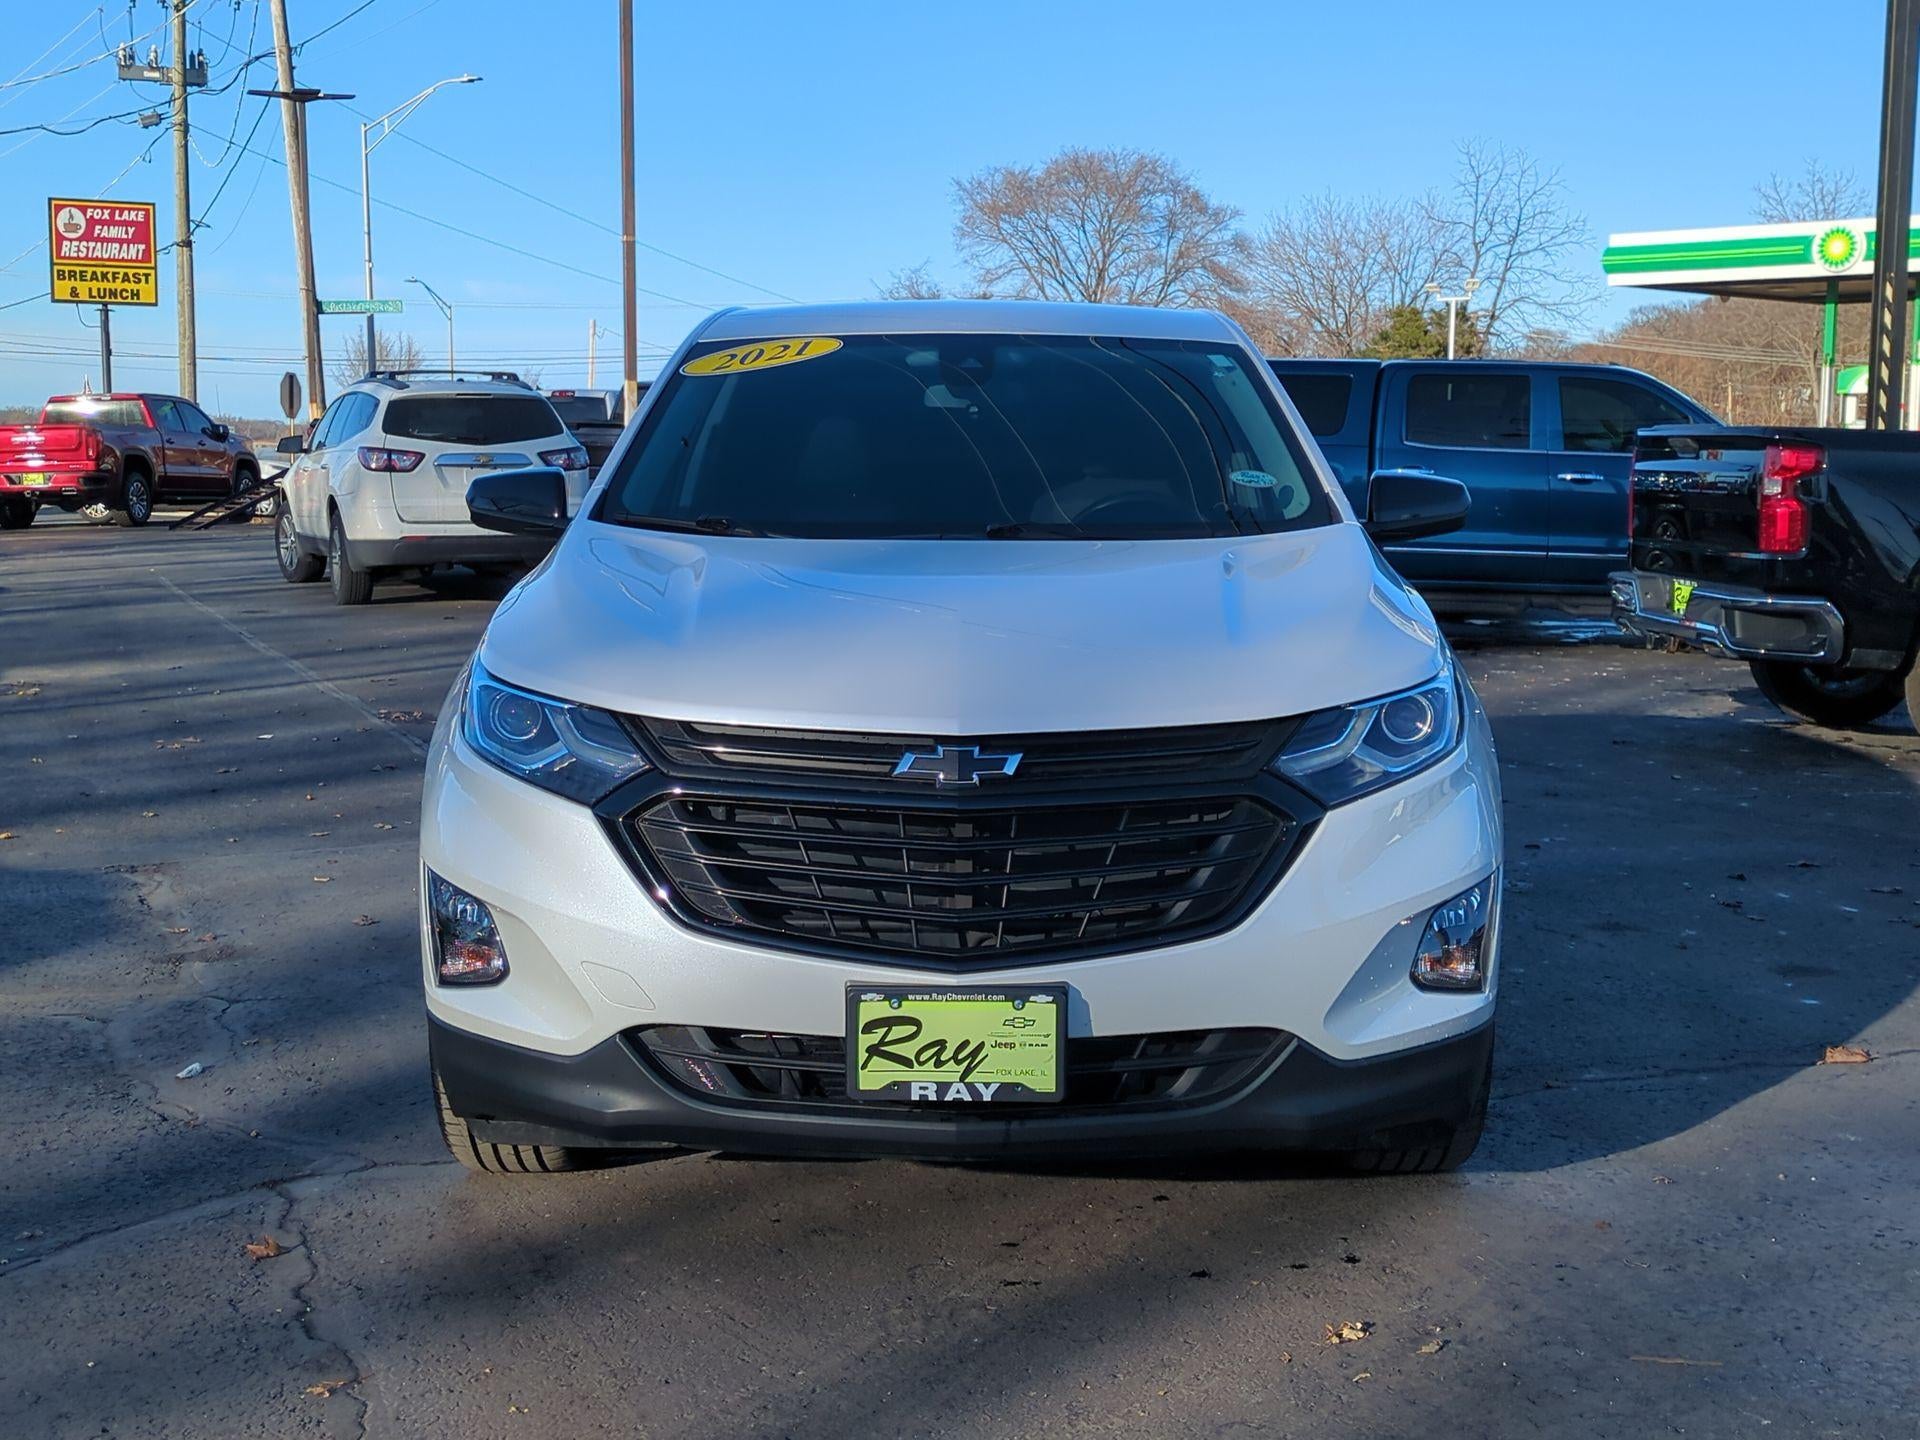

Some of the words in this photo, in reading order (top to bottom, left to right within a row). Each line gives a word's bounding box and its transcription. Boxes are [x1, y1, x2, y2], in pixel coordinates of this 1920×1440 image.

[86, 208, 111, 220] FOX
[115, 209, 145, 221] LAKE
[94, 225, 135, 239] FAMILY
[61, 240, 145, 260] RESTAURANT
[56, 269, 151, 284] BREAKFAST
[69, 286, 80, 298] &
[88, 287, 140, 300] LUNCH
[712, 340, 813, 371] 2021
[907, 993, 1005, 1002] www.RayChevrolet.com
[861, 1015, 989, 1082] Ray
[990, 1040, 1016, 1050] Jeep
[995, 1069, 1012, 1077] FOX
[911, 1082, 1001, 1102] RAY
